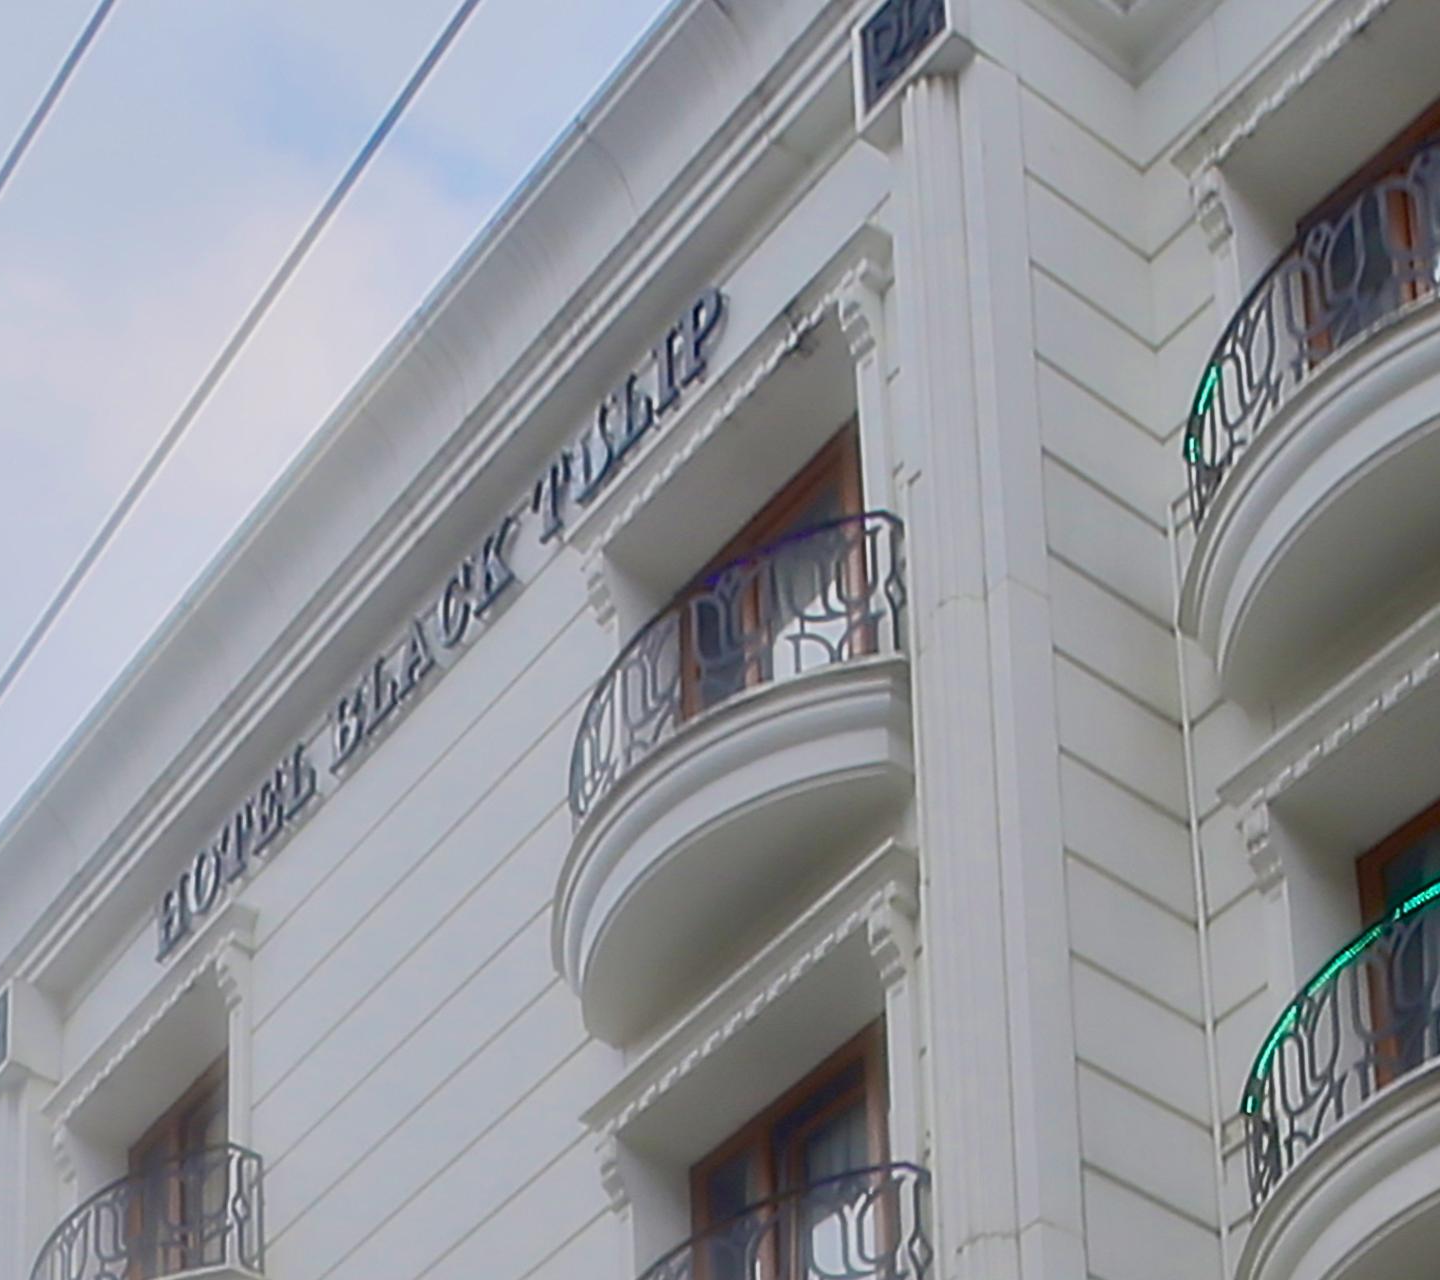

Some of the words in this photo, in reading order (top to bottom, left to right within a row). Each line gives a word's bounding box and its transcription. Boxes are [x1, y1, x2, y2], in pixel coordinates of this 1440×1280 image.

[156, 744, 317, 962] HOTEL
[329, 512, 517, 774] BLACK
[531, 288, 725, 544] TULIP
